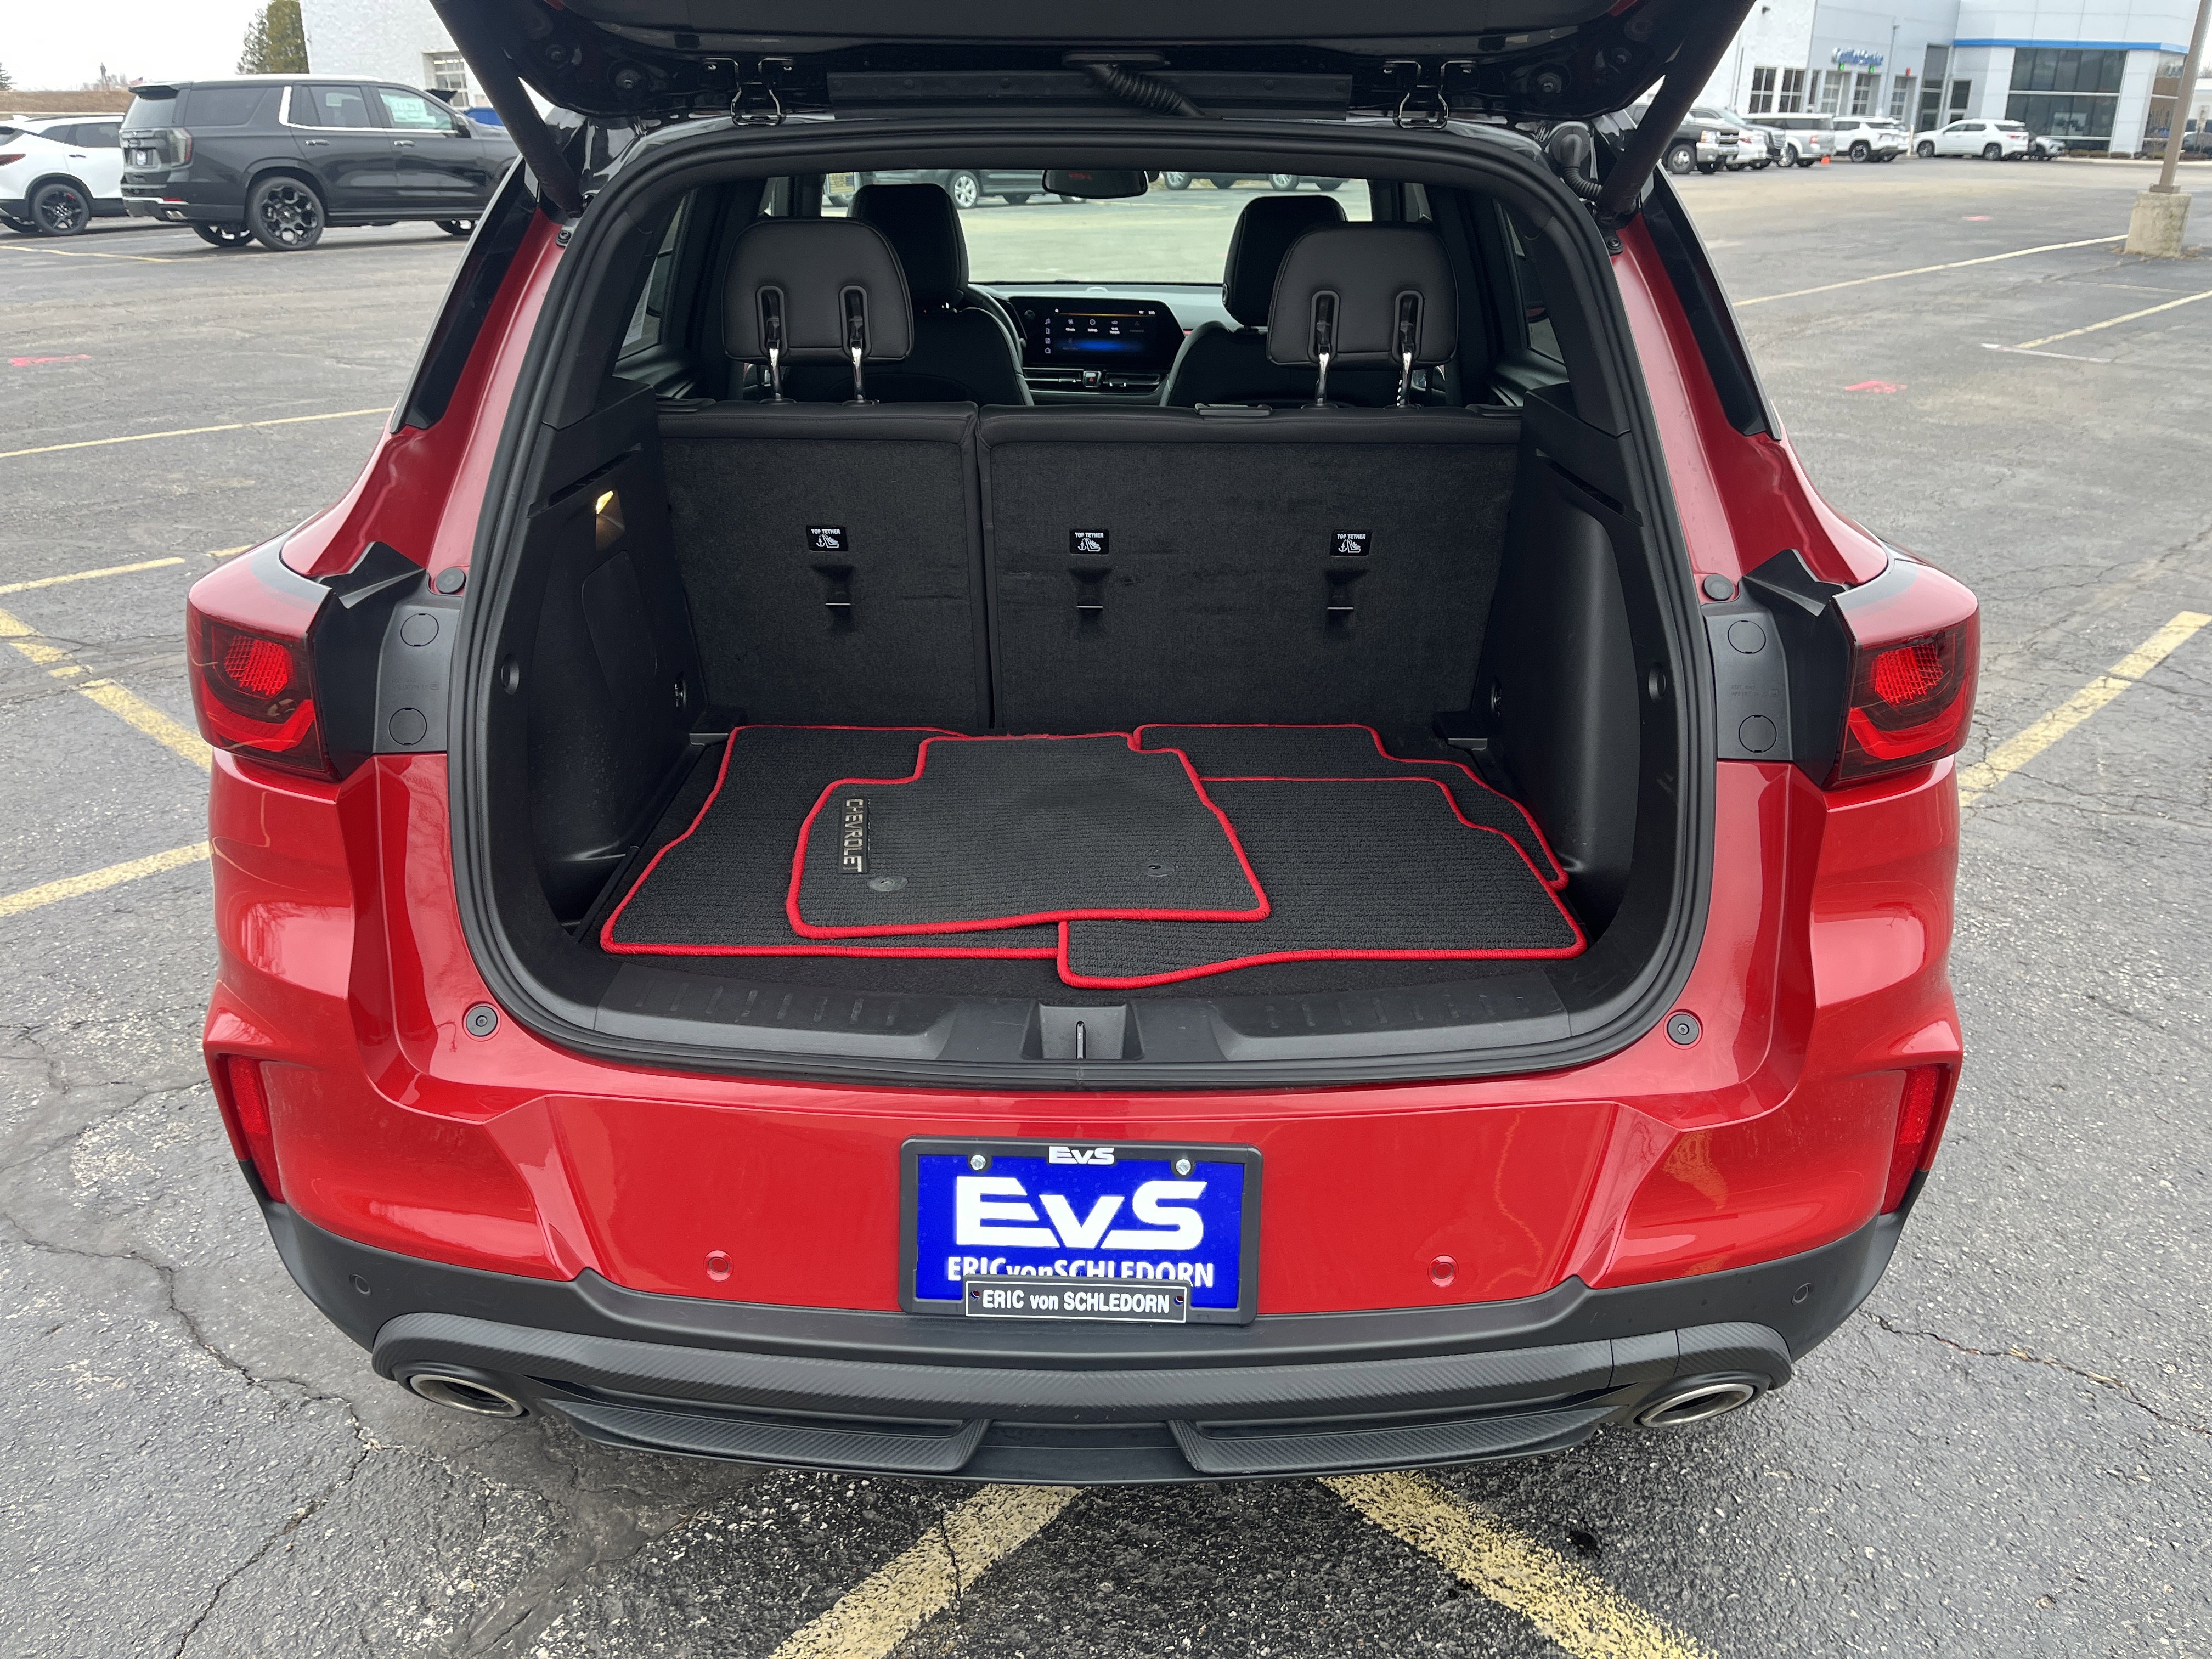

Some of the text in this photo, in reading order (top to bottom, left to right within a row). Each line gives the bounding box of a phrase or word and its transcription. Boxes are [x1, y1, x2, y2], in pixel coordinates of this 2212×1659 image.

[843, 798, 864, 873] CHEVROLET
[983, 1289, 1170, 1314] ERIC von SCHLEDORN
